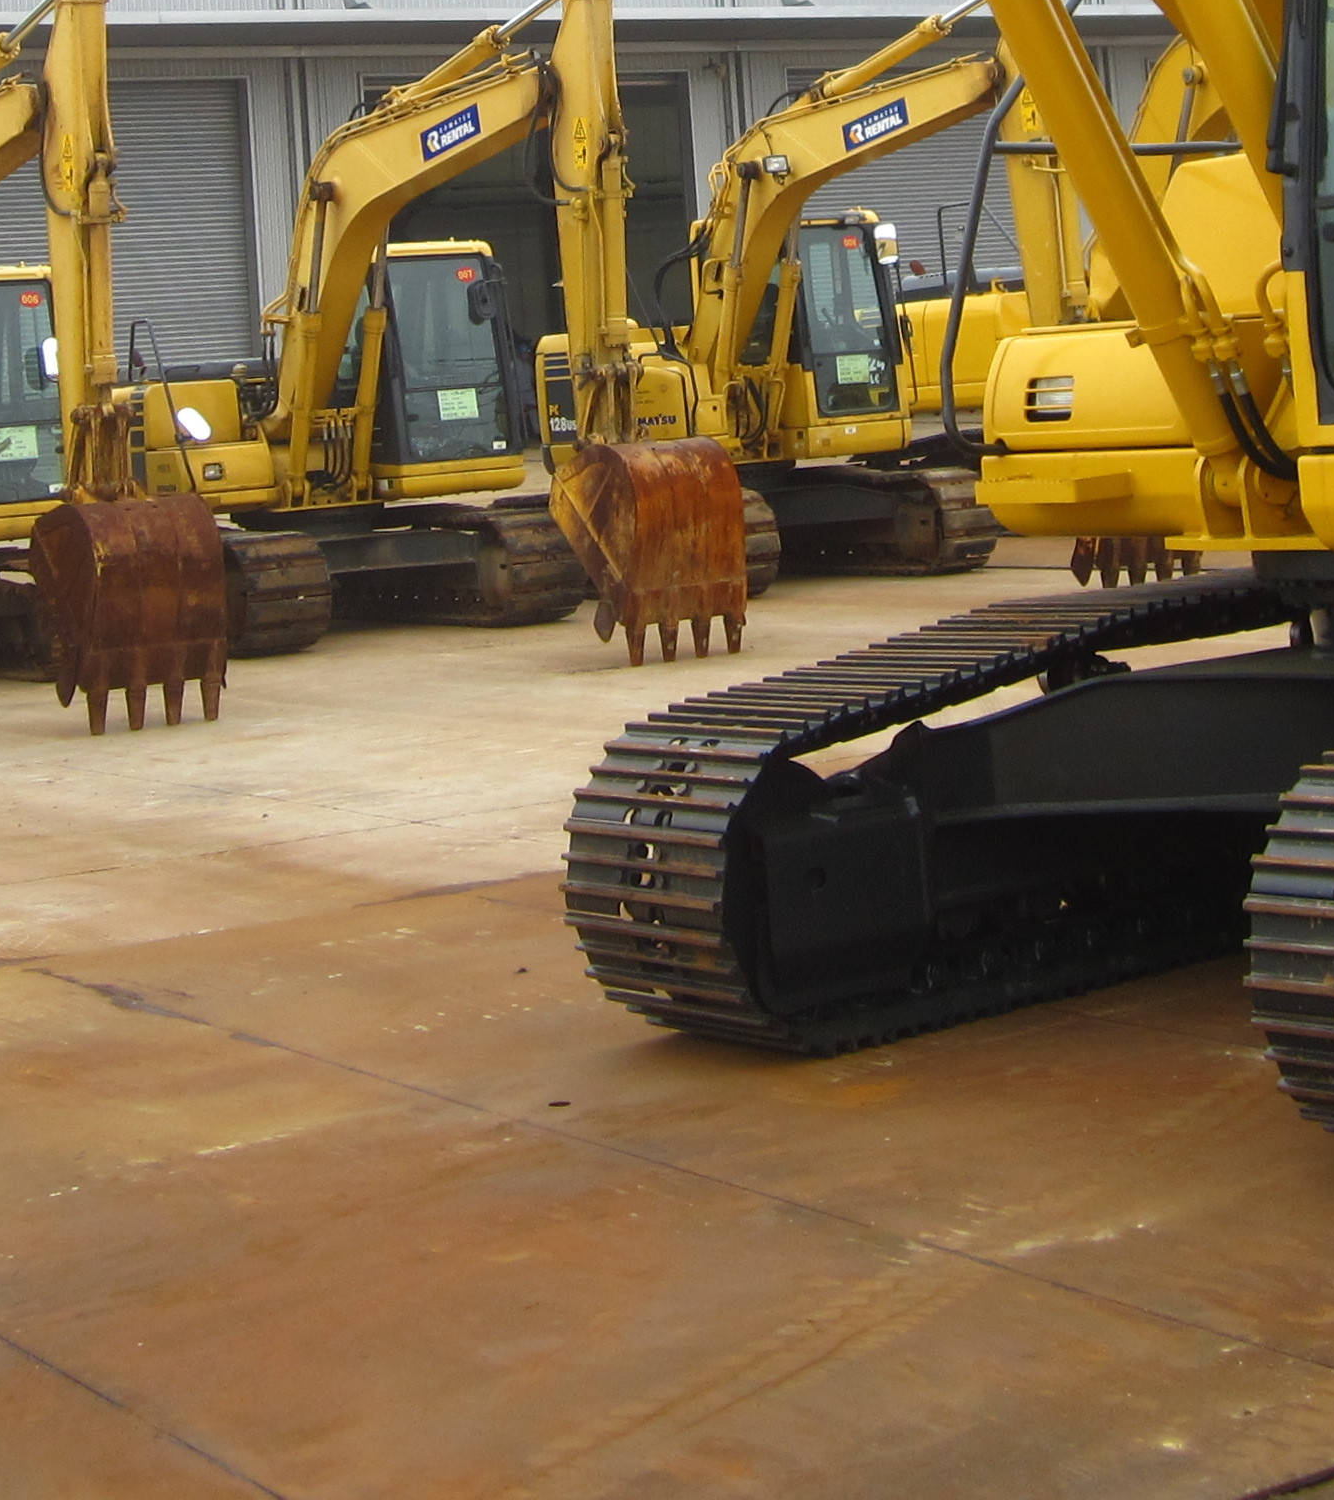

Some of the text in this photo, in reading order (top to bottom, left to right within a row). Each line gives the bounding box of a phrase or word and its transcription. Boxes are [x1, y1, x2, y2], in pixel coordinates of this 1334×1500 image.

[440, 120, 475, 148] RENTAL
[864, 113, 903, 140] RENTAL
[637, 414, 677, 427] MATSU
